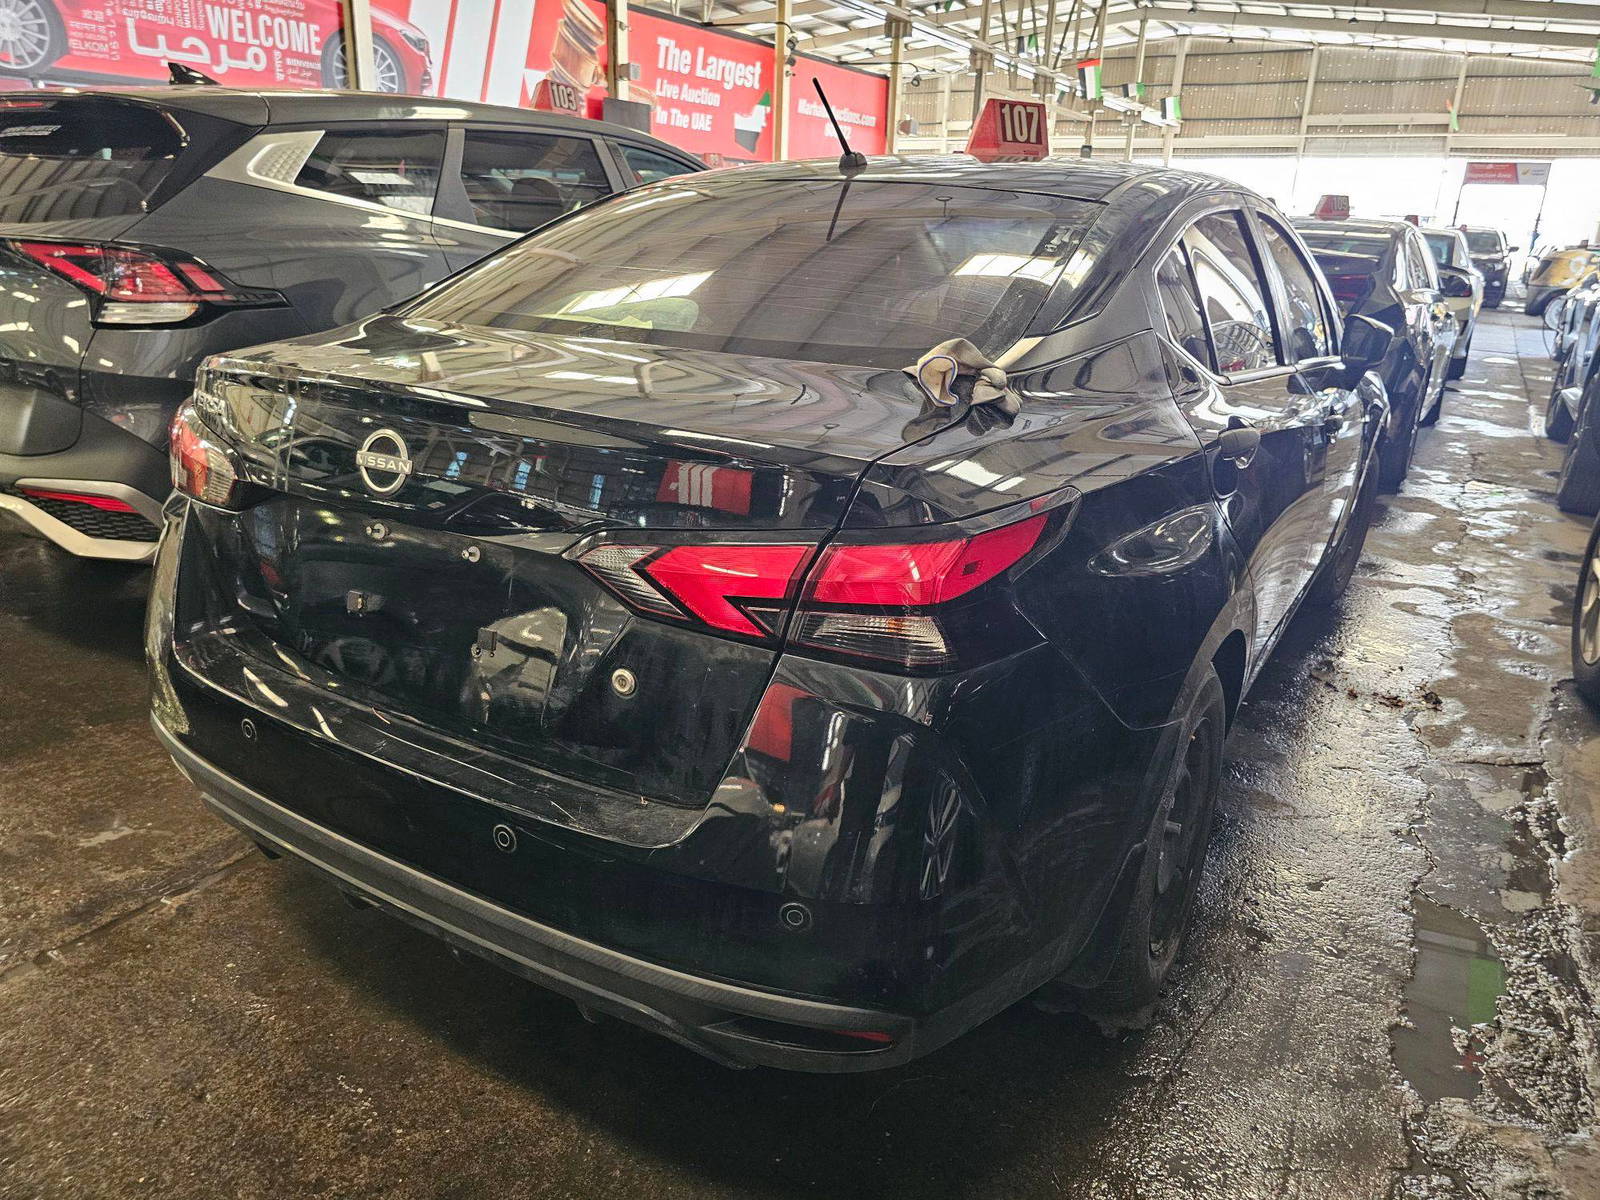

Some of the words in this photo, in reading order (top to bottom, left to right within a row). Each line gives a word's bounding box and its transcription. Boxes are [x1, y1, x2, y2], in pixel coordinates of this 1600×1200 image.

[126, 17, 267, 74] مرحبا
[204, 4, 322, 56] WELCOME
[657, 36, 692, 75] The
[695, 46, 762, 90] Largest
[551, 82, 577, 110] 103
[655, 77, 680, 100] Live
[680, 83, 721, 107] Auction
[655, 105, 669, 125] In
[669, 107, 691, 129] The
[691, 112, 713, 132] UAE
[1001, 103, 1039, 144] 107
[357, 452, 411, 474] NISSAN
